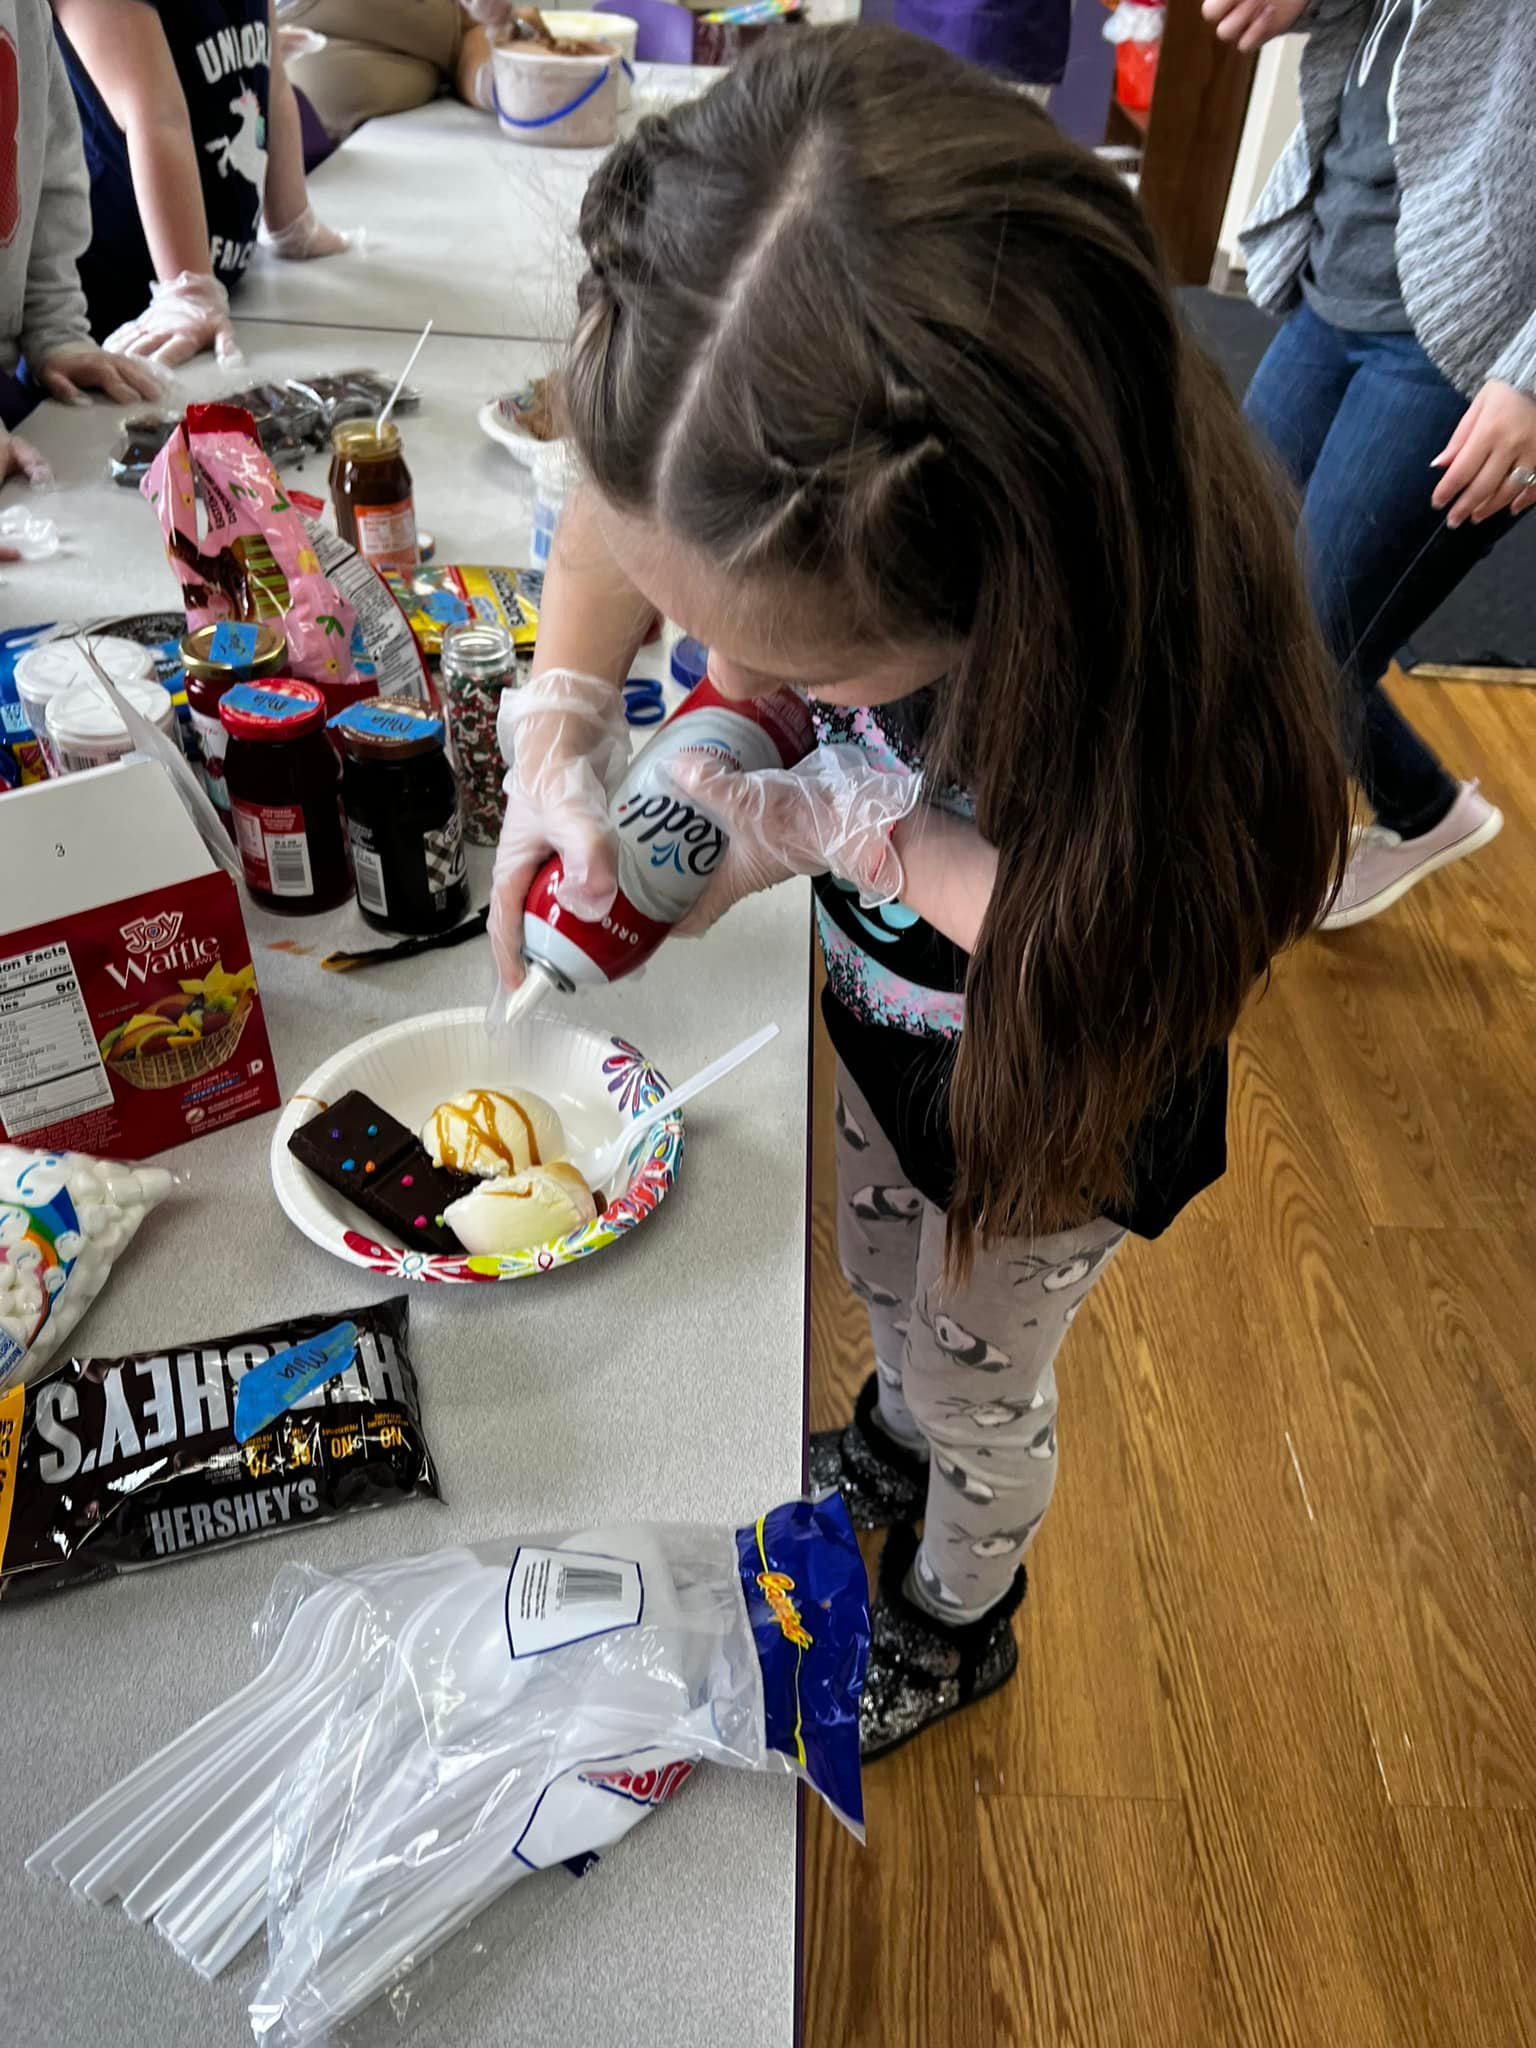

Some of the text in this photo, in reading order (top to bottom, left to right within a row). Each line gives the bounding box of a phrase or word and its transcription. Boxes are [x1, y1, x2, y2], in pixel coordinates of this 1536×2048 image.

[617, 791, 724, 876] Reddi
[601, 915, 639, 946] ORIG
[25, 946, 66, 965] Facts
[104, 937, 220, 990] Waffle
[56, 980, 76, 994] 90
[276, 1349, 329, 1380] Mila
[35, 1332, 405, 1485] HSHEY'S
[149, 1479, 320, 1556] HERSHEY'S
